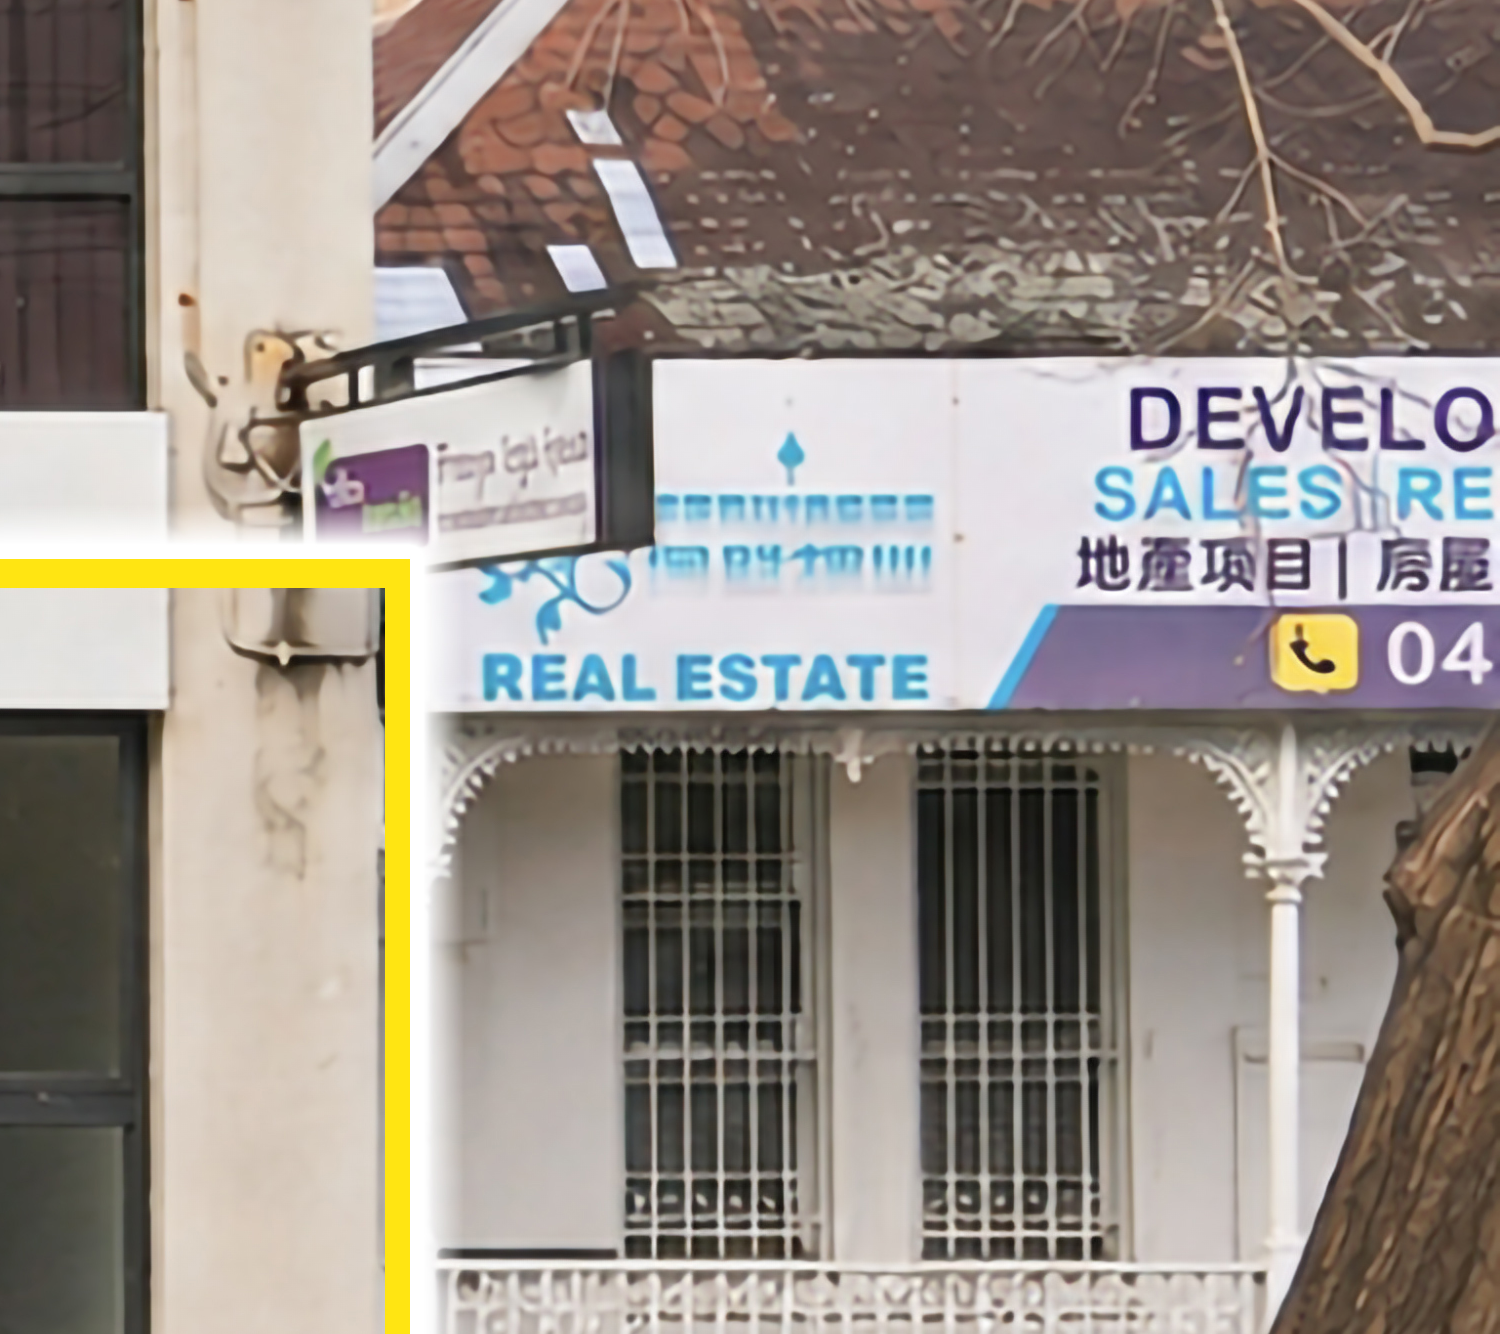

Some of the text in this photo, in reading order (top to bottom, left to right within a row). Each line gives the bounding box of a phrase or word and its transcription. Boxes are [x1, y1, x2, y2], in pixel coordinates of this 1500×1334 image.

[1129, 386, 1494, 452] DEVELO
[1094, 465, 1343, 522] SALES
[481, 653, 930, 703] REAL ESTATE
[1387, 621, 1493, 686] 04
